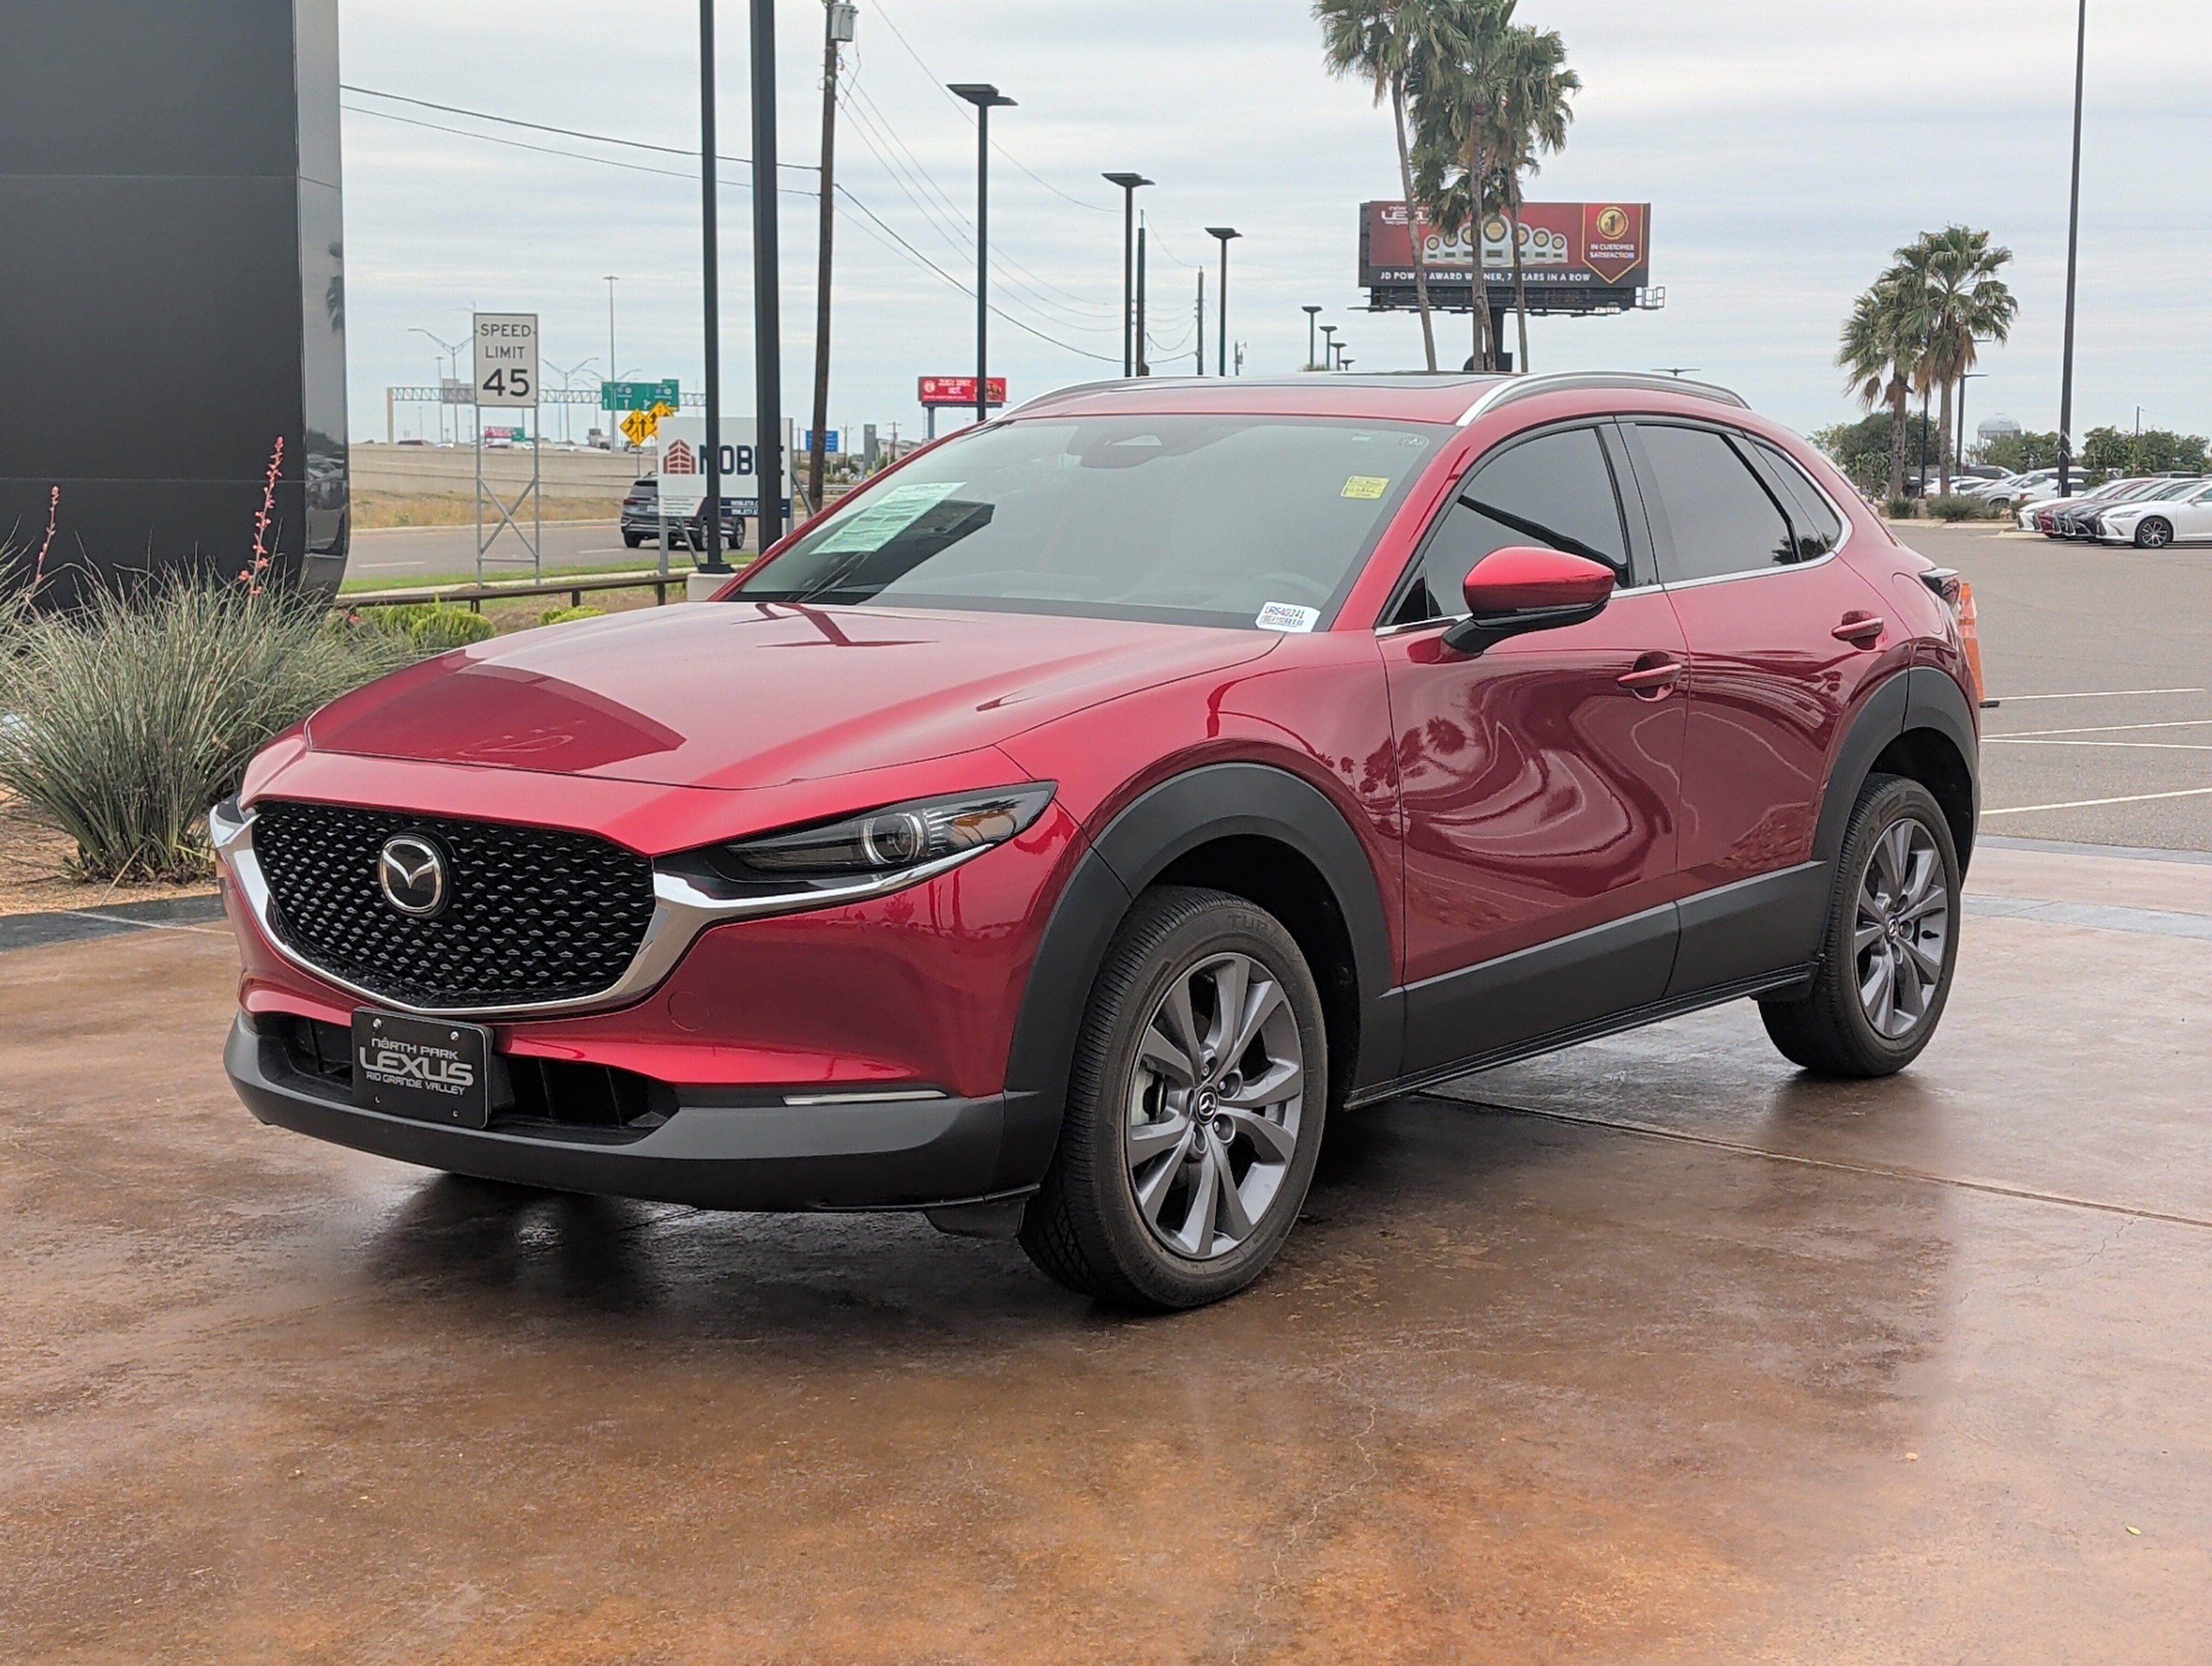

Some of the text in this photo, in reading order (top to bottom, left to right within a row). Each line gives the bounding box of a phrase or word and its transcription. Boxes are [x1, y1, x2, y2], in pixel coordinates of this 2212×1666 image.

[1380, 272, 1391, 280] JD
[1429, 272, 1462, 280] AWARD
[1465, 272, 1505, 282] WNER,
[1517, 273, 1545, 281] EARS
[1547, 273, 1558, 281] IN
[1559, 273, 1567, 281] A
[480, 323, 531, 337] SPEED
[485, 345, 525, 359] LIMIT
[483, 368, 530, 397] 45
[420, 1046, 459, 1061] PARK
[359, 1046, 474, 1087] LEXUS
[366, 1071, 466, 1095] RIO GRANDE VALLEY
